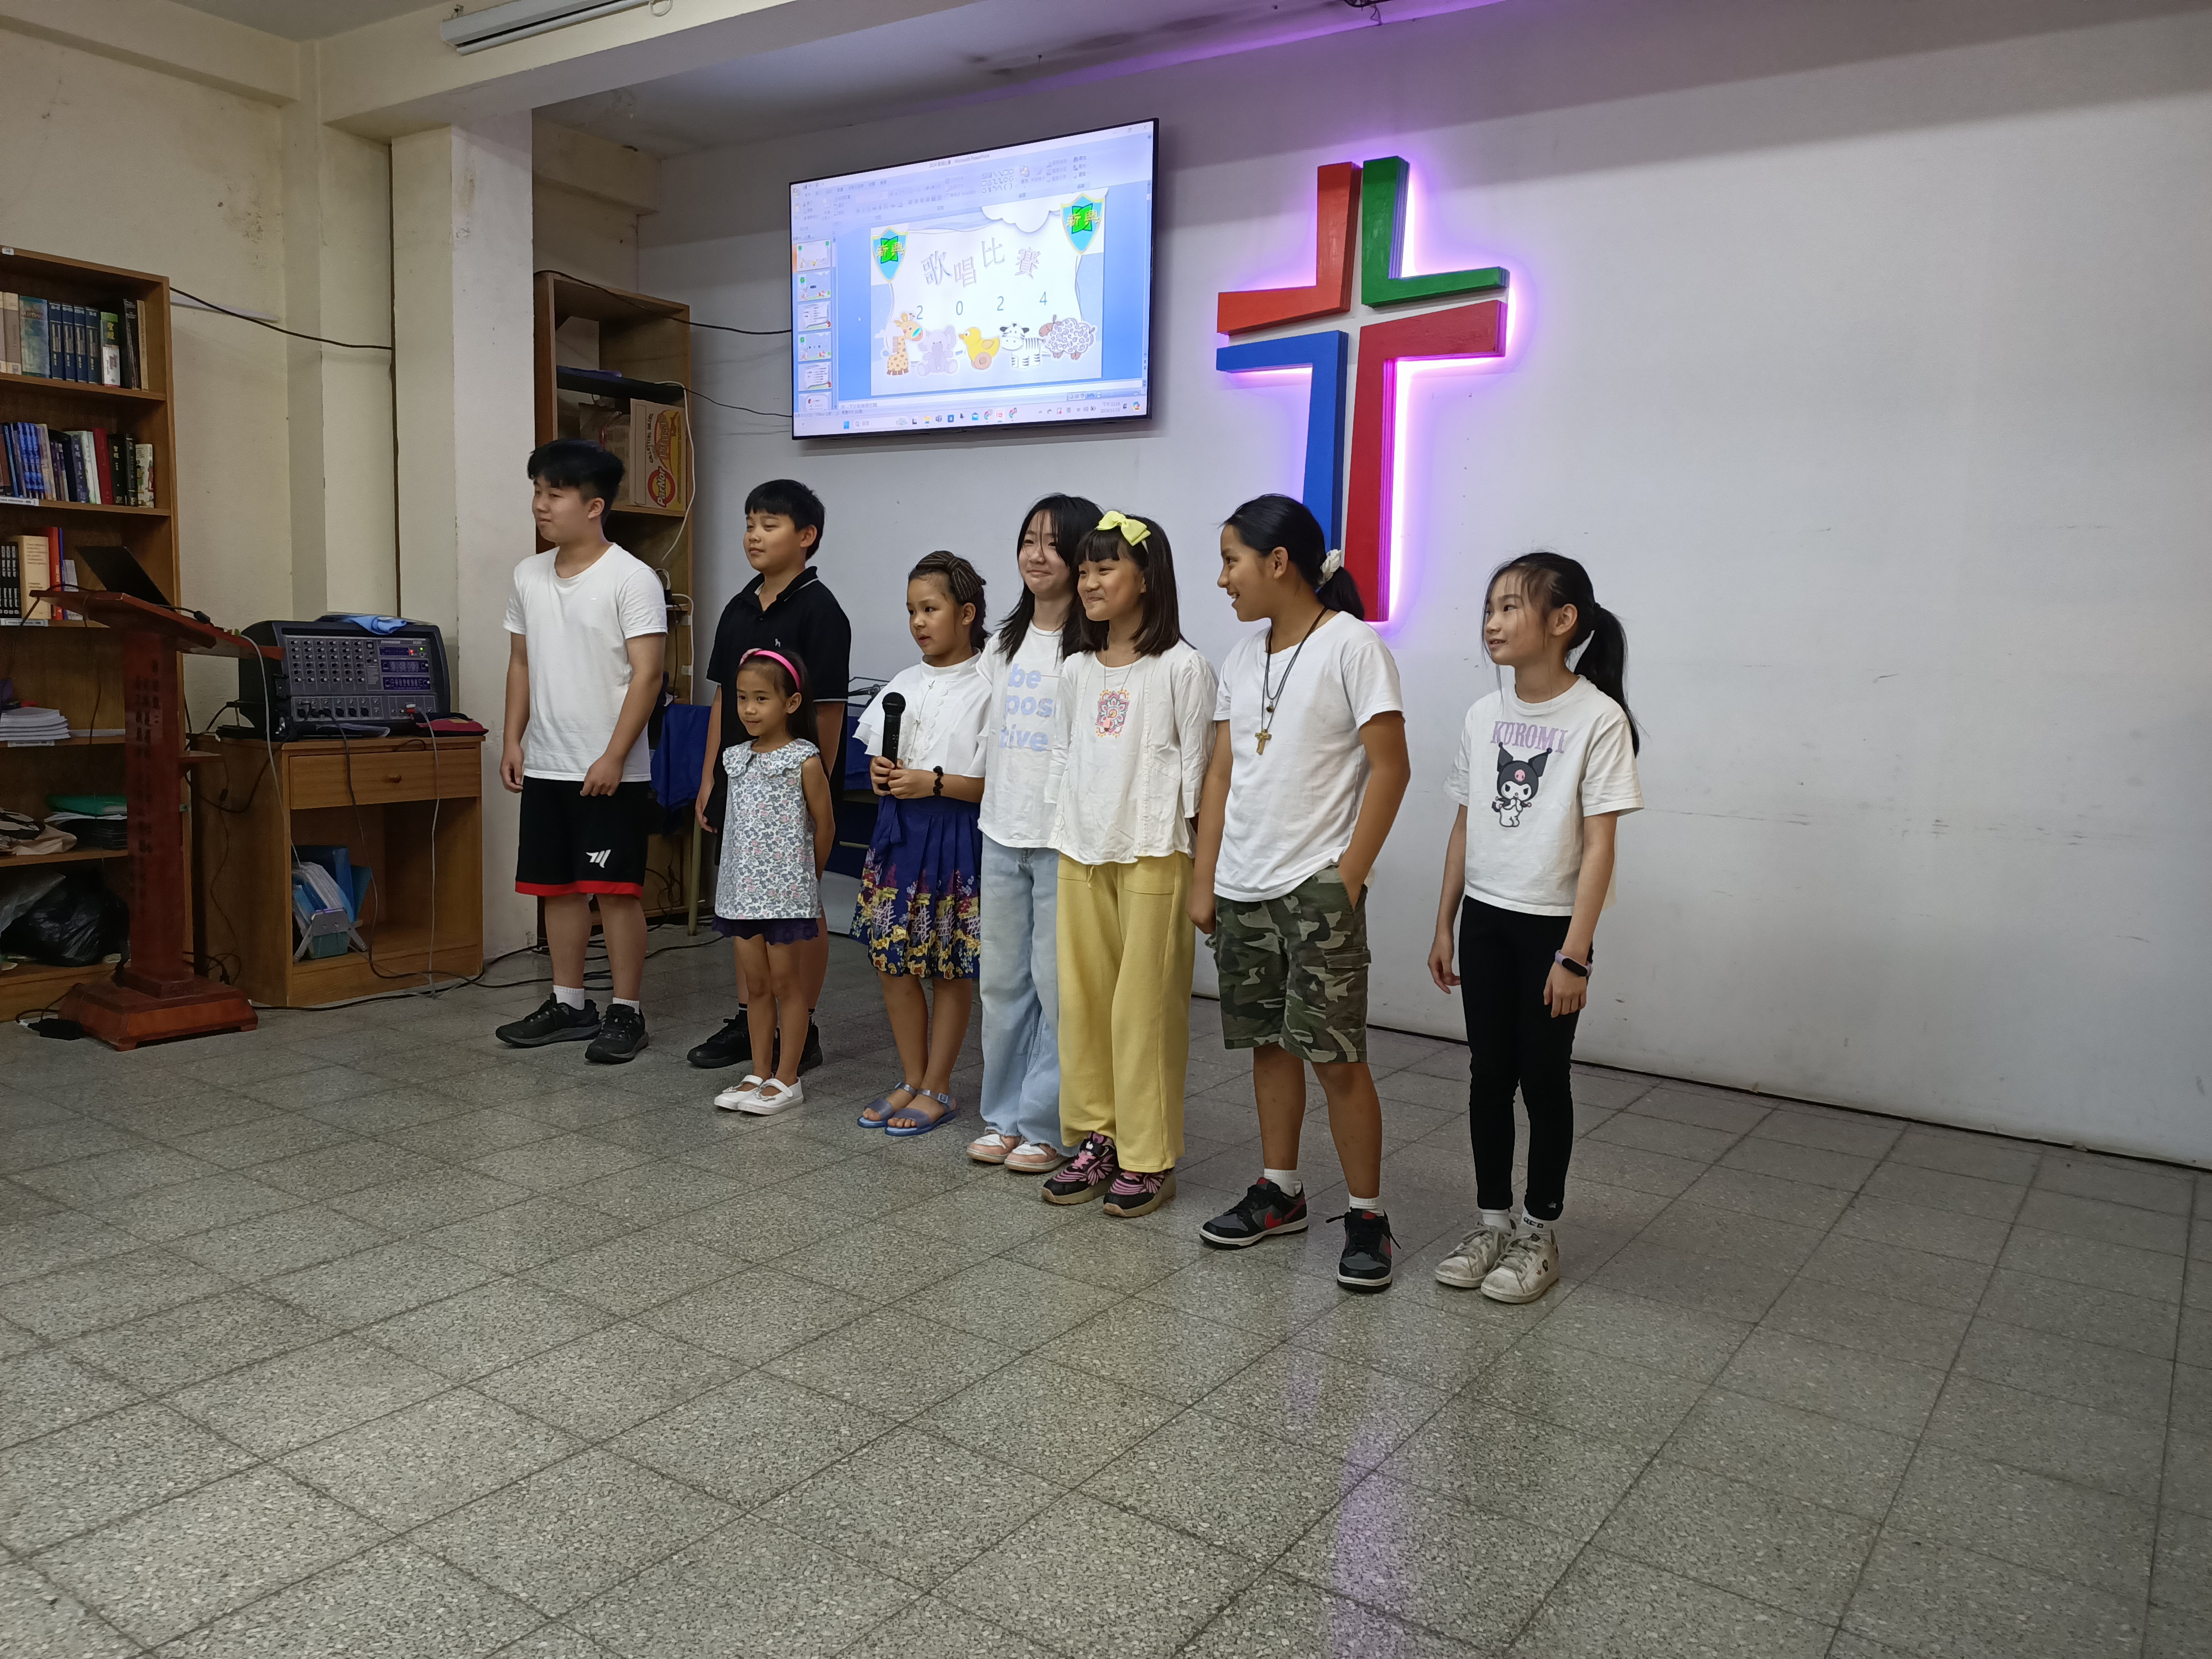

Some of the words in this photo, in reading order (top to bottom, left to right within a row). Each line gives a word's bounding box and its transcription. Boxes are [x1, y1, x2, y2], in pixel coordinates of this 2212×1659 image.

[921, 237, 1041, 287] 歌唱比賽
[657, 466, 666, 507] ParNor
[1008, 663, 1042, 689] be
[1490, 721, 1568, 754] KUROMI
